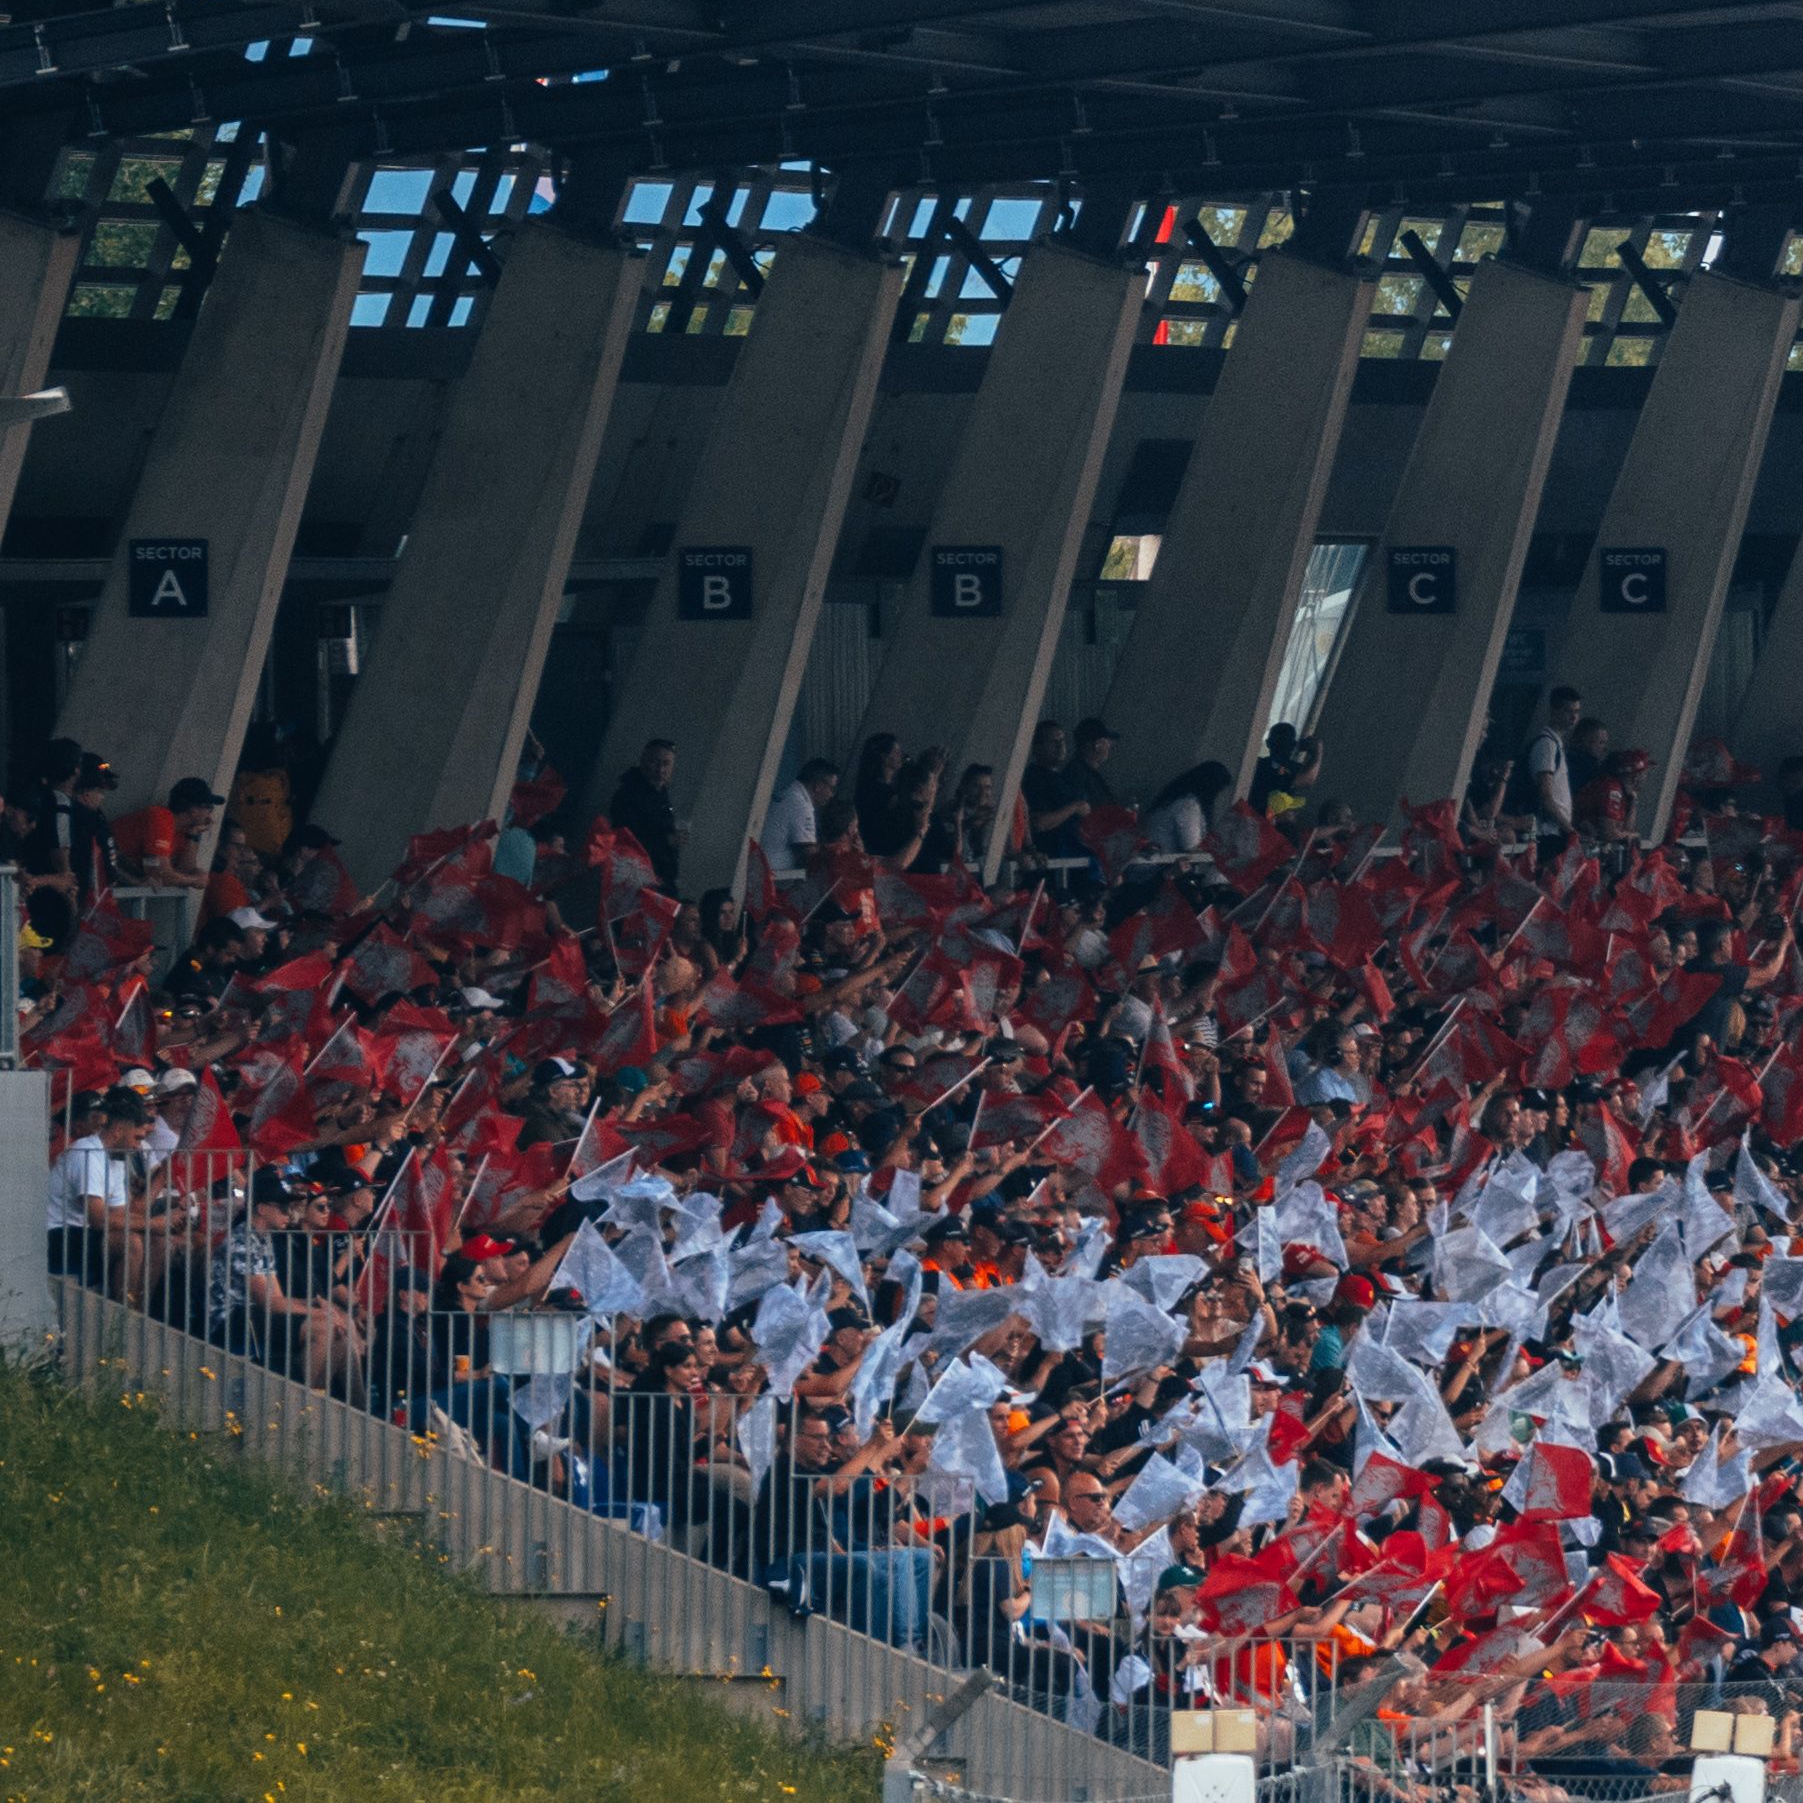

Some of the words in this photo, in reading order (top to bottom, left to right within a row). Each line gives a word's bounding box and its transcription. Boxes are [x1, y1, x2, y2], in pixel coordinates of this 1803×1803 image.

[135, 546, 202, 560] SECTOR
[685, 554, 747, 567] SECTOR
[936, 553, 998, 566] SECTOR
[1392, 552, 1451, 565] SECTOR
[1606, 553, 1661, 566] SECTOR
[151, 569, 187, 606] A
[703, 575, 731, 610] B
[954, 573, 982, 607] B
[1408, 572, 1436, 604] C
[1621, 572, 1647, 603] C
